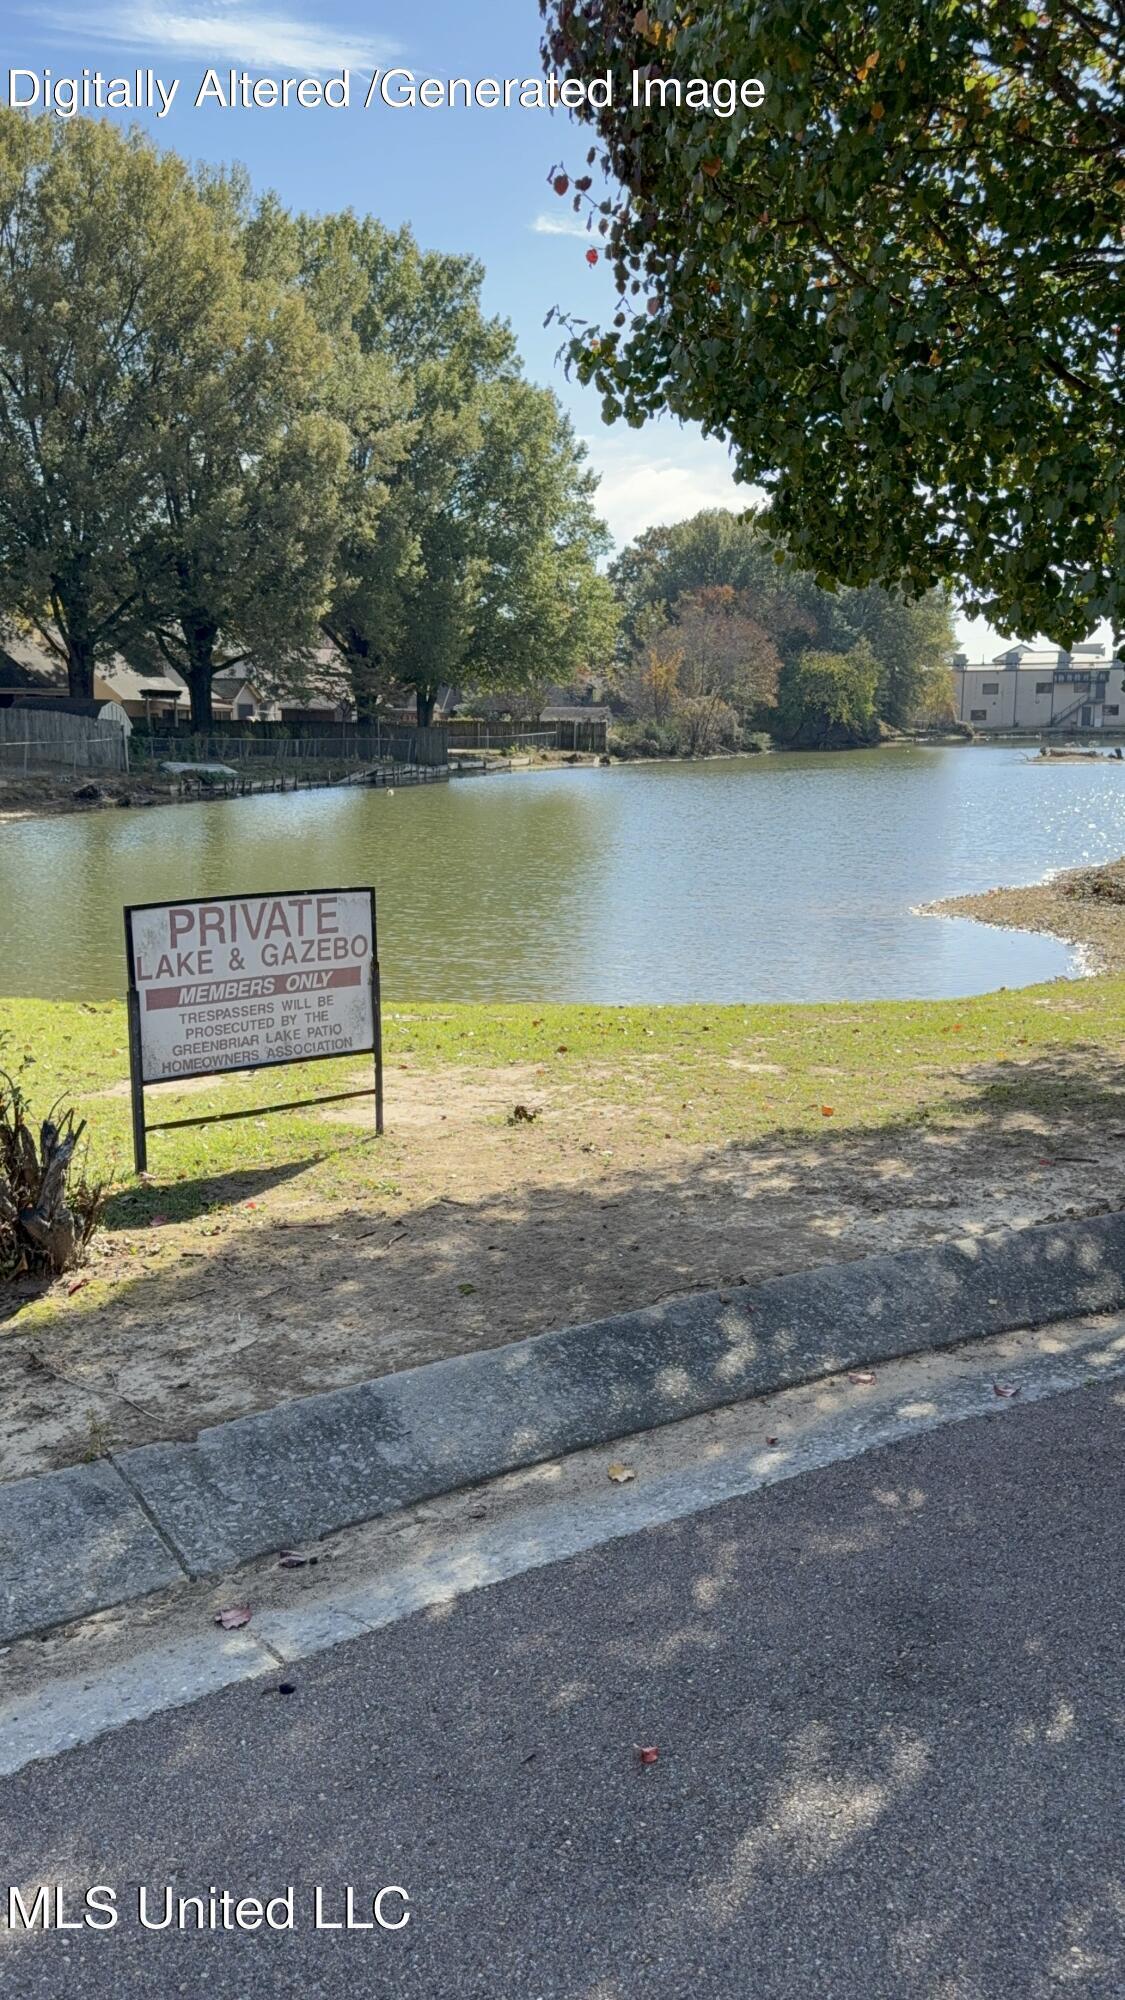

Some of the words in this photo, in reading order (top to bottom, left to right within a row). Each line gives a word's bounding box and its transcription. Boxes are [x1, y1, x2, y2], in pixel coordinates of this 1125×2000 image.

[169, 897, 339, 948] PRIVATE
[137, 950, 213, 981] LAKE
[229, 948, 245, 971] &
[261, 935, 368, 967] GAZEBO
[178, 978, 275, 1004] MEMBERS
[286, 971, 334, 991] ONLY
[180, 1003, 274, 1024] TRESPASSERS
[282, 999, 311, 1011] WILL
[318, 995, 334, 1007] BE
[186, 1017, 274, 1039] PROSECUTED
[281, 1015, 297, 1027] BY
[305, 1011, 329, 1023] THE
[162, 1051, 259, 1073] HOMEOWNERS
[267, 1036, 352, 1059] ASSOCIATION
[173, 1035, 259, 1056] GREENBRIAR
[266, 1031, 301, 1044] LAKE
[308, 1024, 342, 1038] PATIO
